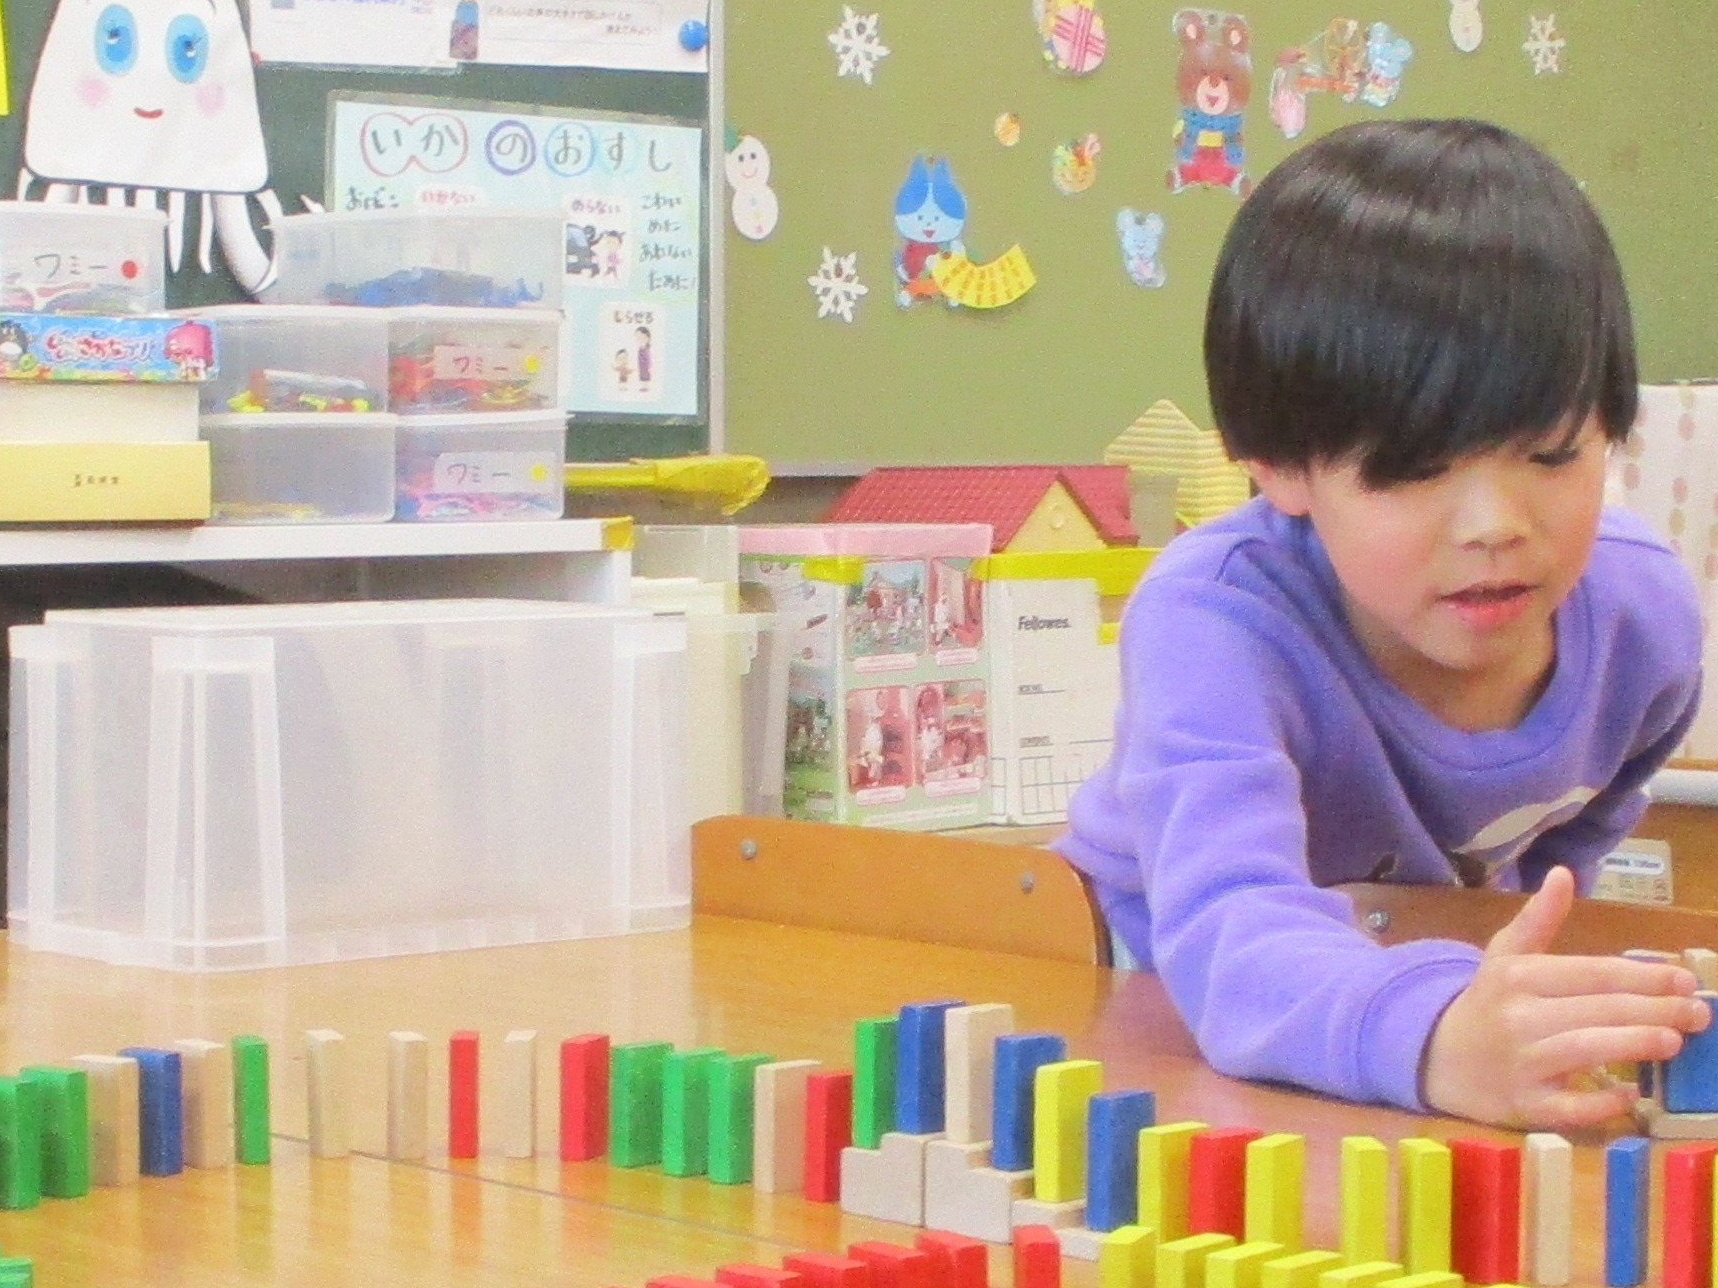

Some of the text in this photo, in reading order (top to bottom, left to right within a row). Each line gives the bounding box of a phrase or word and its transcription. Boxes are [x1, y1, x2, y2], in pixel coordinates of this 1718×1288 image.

[370, 121, 673, 173] いかのおすし
